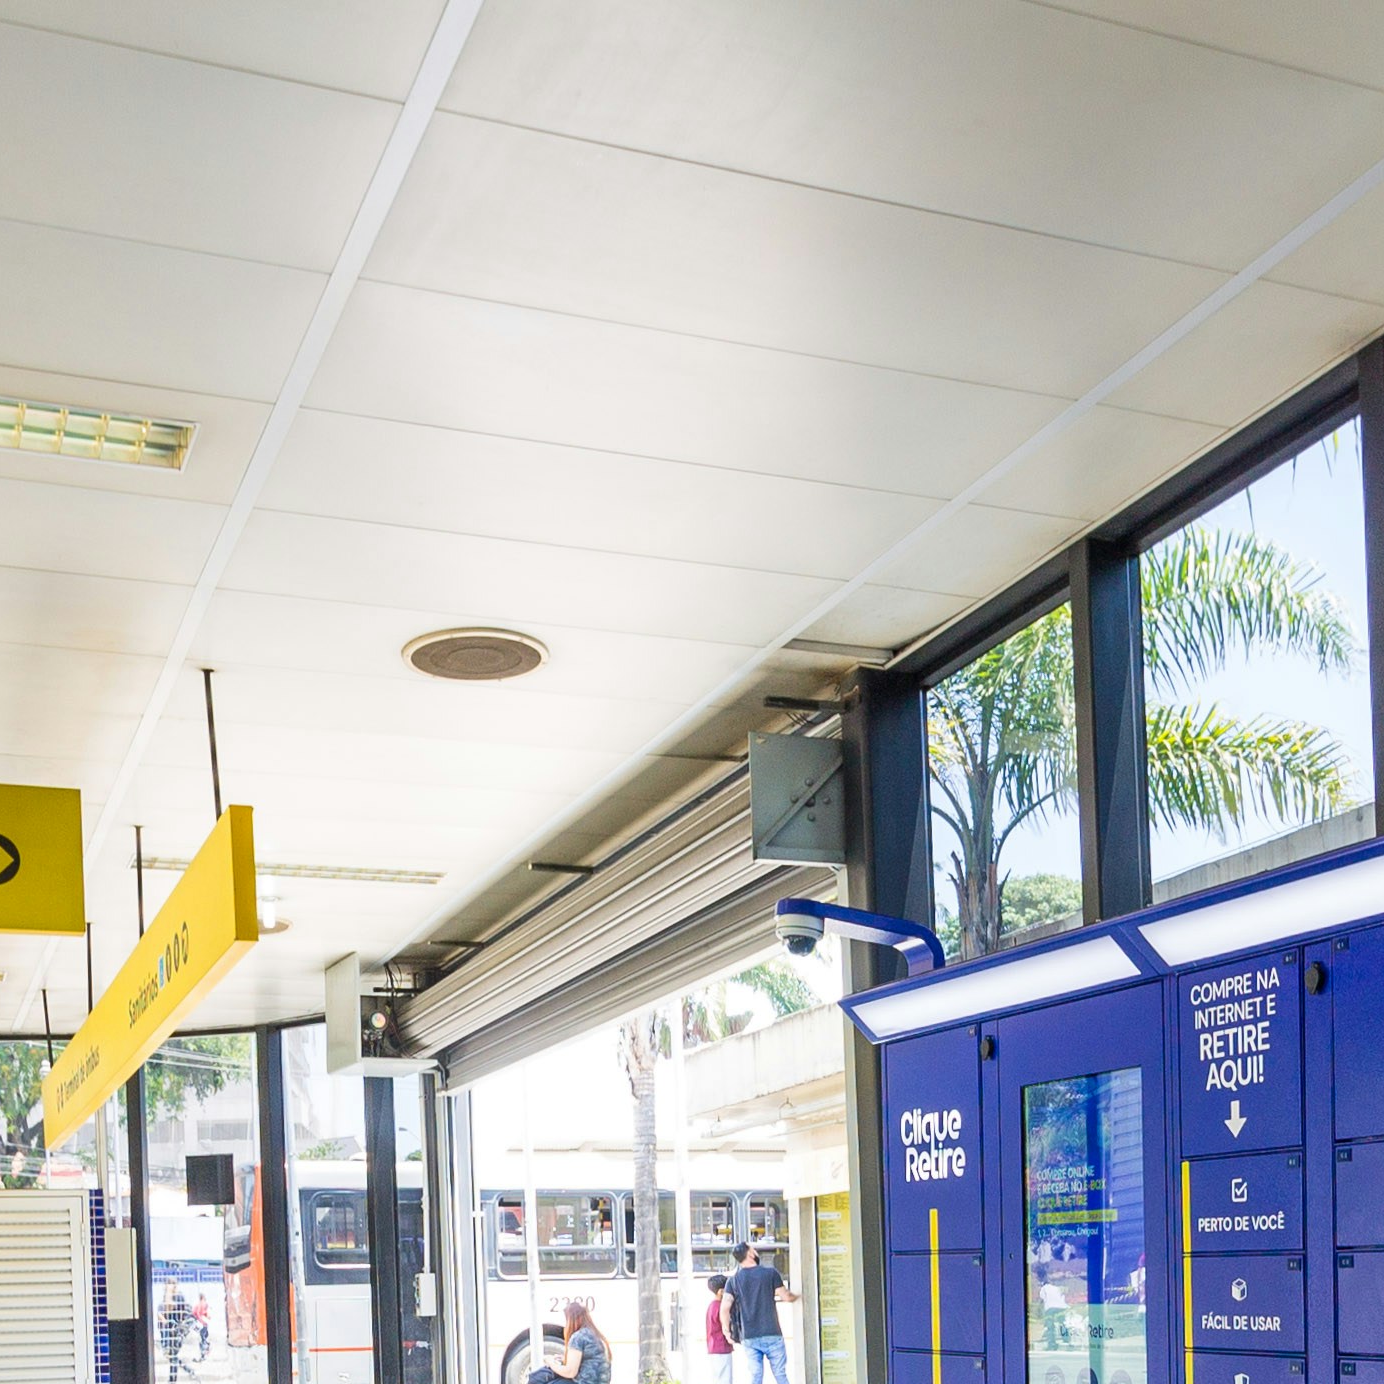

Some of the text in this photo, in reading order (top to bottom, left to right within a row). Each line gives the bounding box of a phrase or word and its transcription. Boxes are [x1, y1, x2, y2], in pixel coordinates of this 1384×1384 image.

[128, 973, 159, 1029] Sanitários
[1190, 967, 1280, 1006] COMPRE NA
[1194, 994, 1276, 1030] INTERNET E
[1199, 1022, 1270, 1061] RETIRE
[1206, 1055, 1265, 1092] AQUI!
[901, 1108, 963, 1148] Clique
[905, 1144, 966, 1182] Retire
[1198, 1210, 1284, 1233] PERTO DE VOCÊ
[1202, 1312, 1281, 1332] FÁCIL DE USAR
